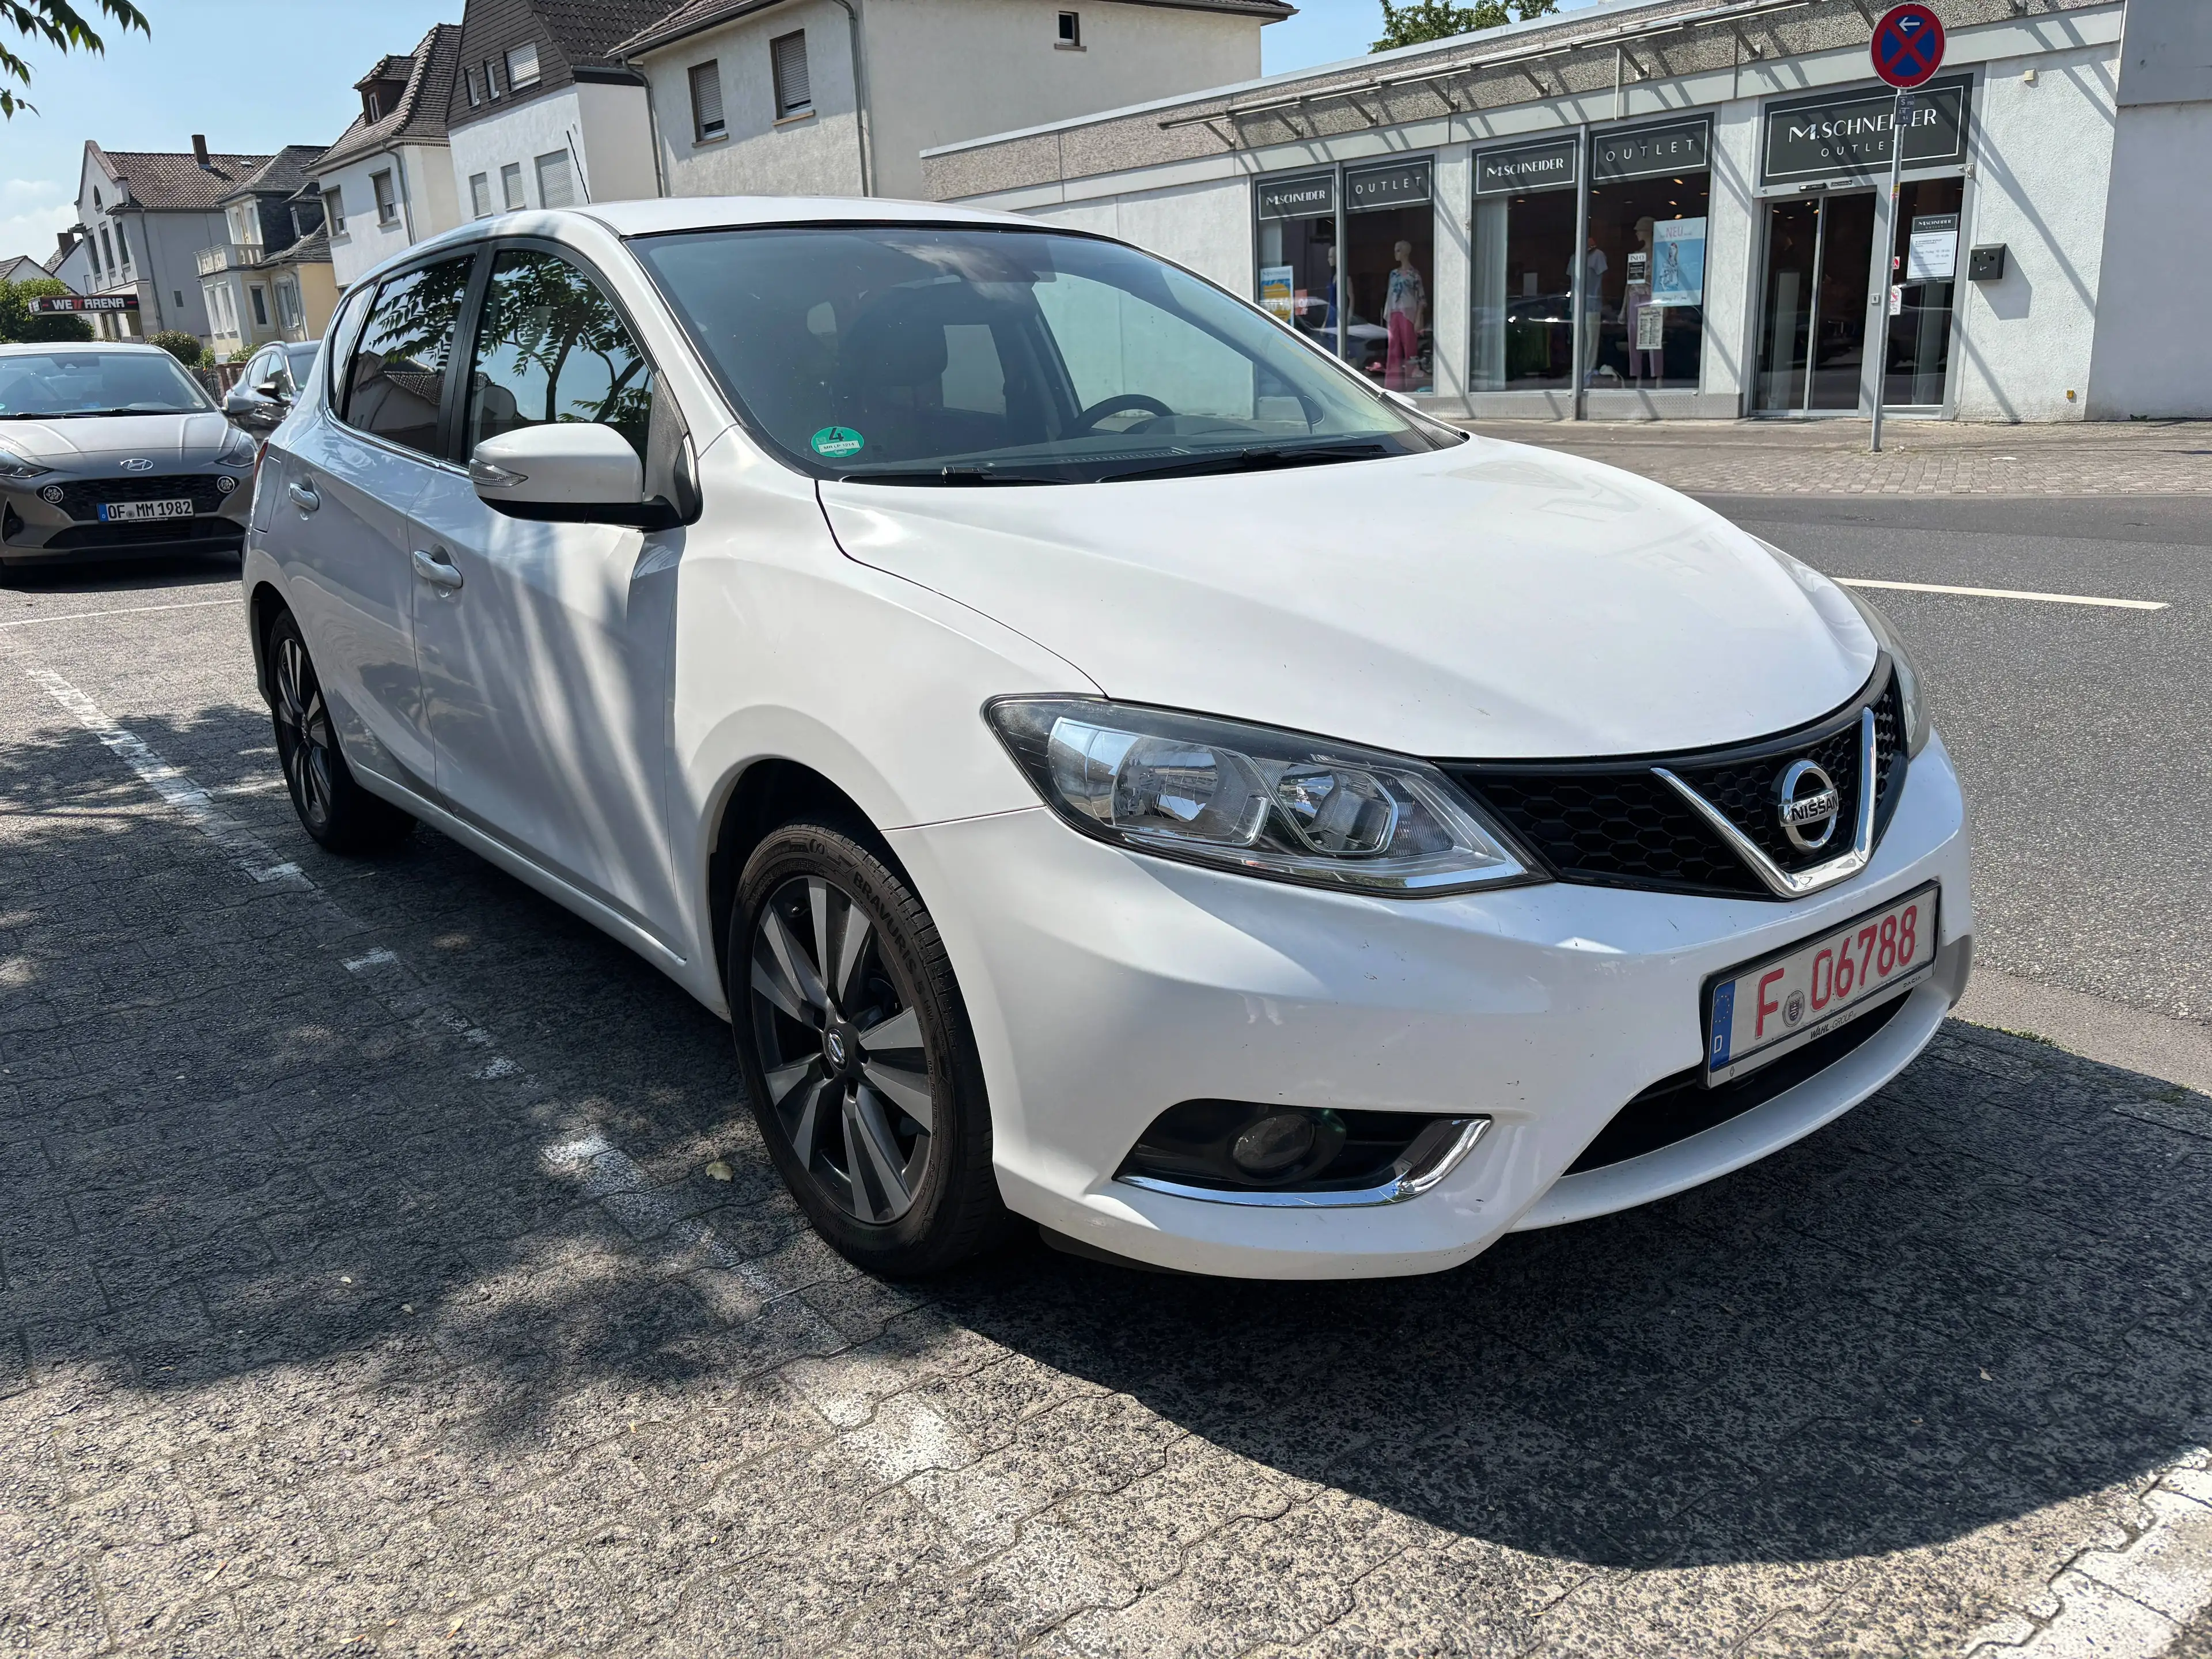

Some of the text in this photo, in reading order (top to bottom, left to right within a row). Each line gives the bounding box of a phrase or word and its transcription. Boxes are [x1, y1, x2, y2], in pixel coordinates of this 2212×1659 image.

[1788, 109, 1937, 143] M.SCHNEIER
[1605, 139, 1694, 162] OUTLET
[1820, 141, 1895, 157] OUTLE
[1486, 157, 1564, 177] M.SCHNEIDER
[1355, 177, 1421, 194] OUTLET
[1666, 226, 1683, 237] NEU
[84, 298, 125, 309] ARENA
[828, 427, 844, 441] 4
[108, 505, 125, 518] OF
[136, 503, 154, 517] MM
[157, 501, 192, 516] 1982
[1791, 796, 1839, 821] NISSAN
[853, 871, 917, 975] BRAVURIS
[914, 980, 925, 995] 5
[1714, 905, 1917, 1054] D F 06788
[1903, 976, 1921, 987] DACIA
